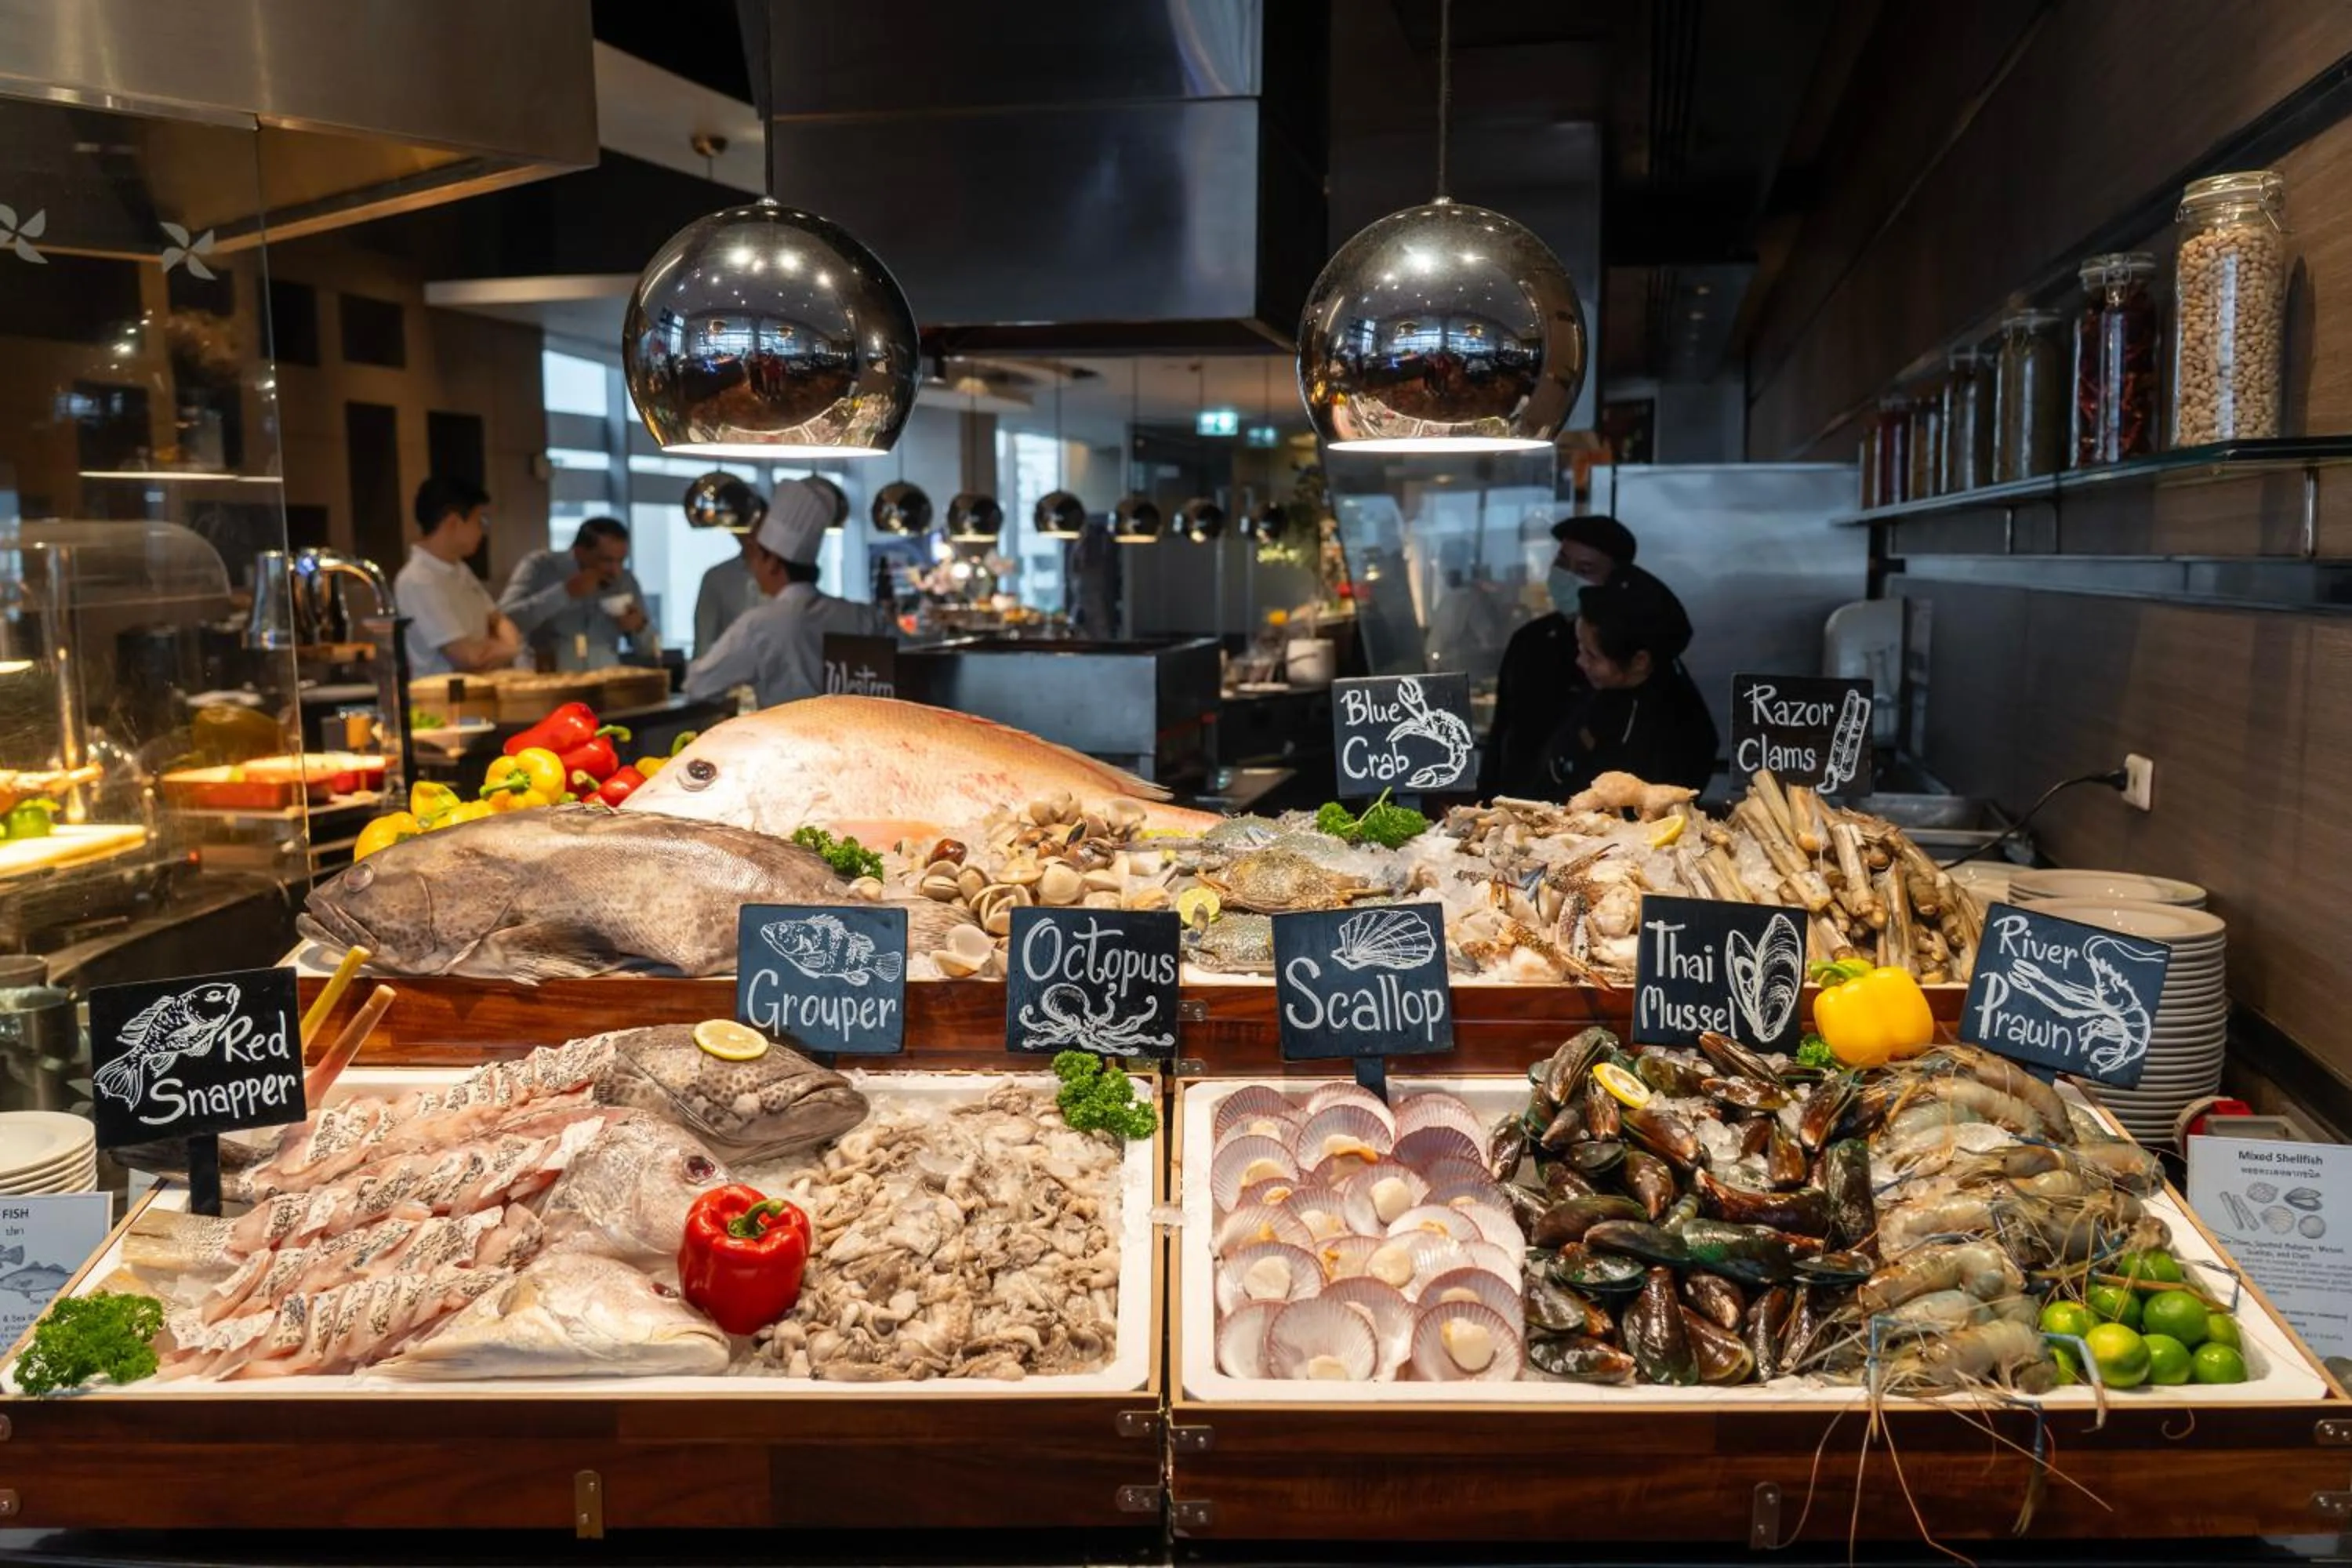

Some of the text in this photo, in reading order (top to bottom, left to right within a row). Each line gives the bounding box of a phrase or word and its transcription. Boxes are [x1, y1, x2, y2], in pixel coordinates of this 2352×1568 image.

[1340, 689, 1402, 726] Blue
[1743, 683, 1835, 727] Razor
[1342, 735, 1410, 780] Crab
[1737, 732, 1817, 772] Clams
[1022, 916, 1175, 997] Octopus
[1645, 919, 1713, 983] Thai
[1992, 915, 2078, 970] River
[746, 968, 897, 1042] Grouper
[1285, 956, 1445, 1042] Scallop
[1639, 985, 1738, 1040] Mussel
[1974, 971, 2072, 1056] Prawn
[217, 1010, 290, 1062] Red
[138, 1073, 296, 1125] Snapper
[2238, 1150, 2323, 1165] Mixed Shellfish
[2, 1208, 29, 1219] FISH
